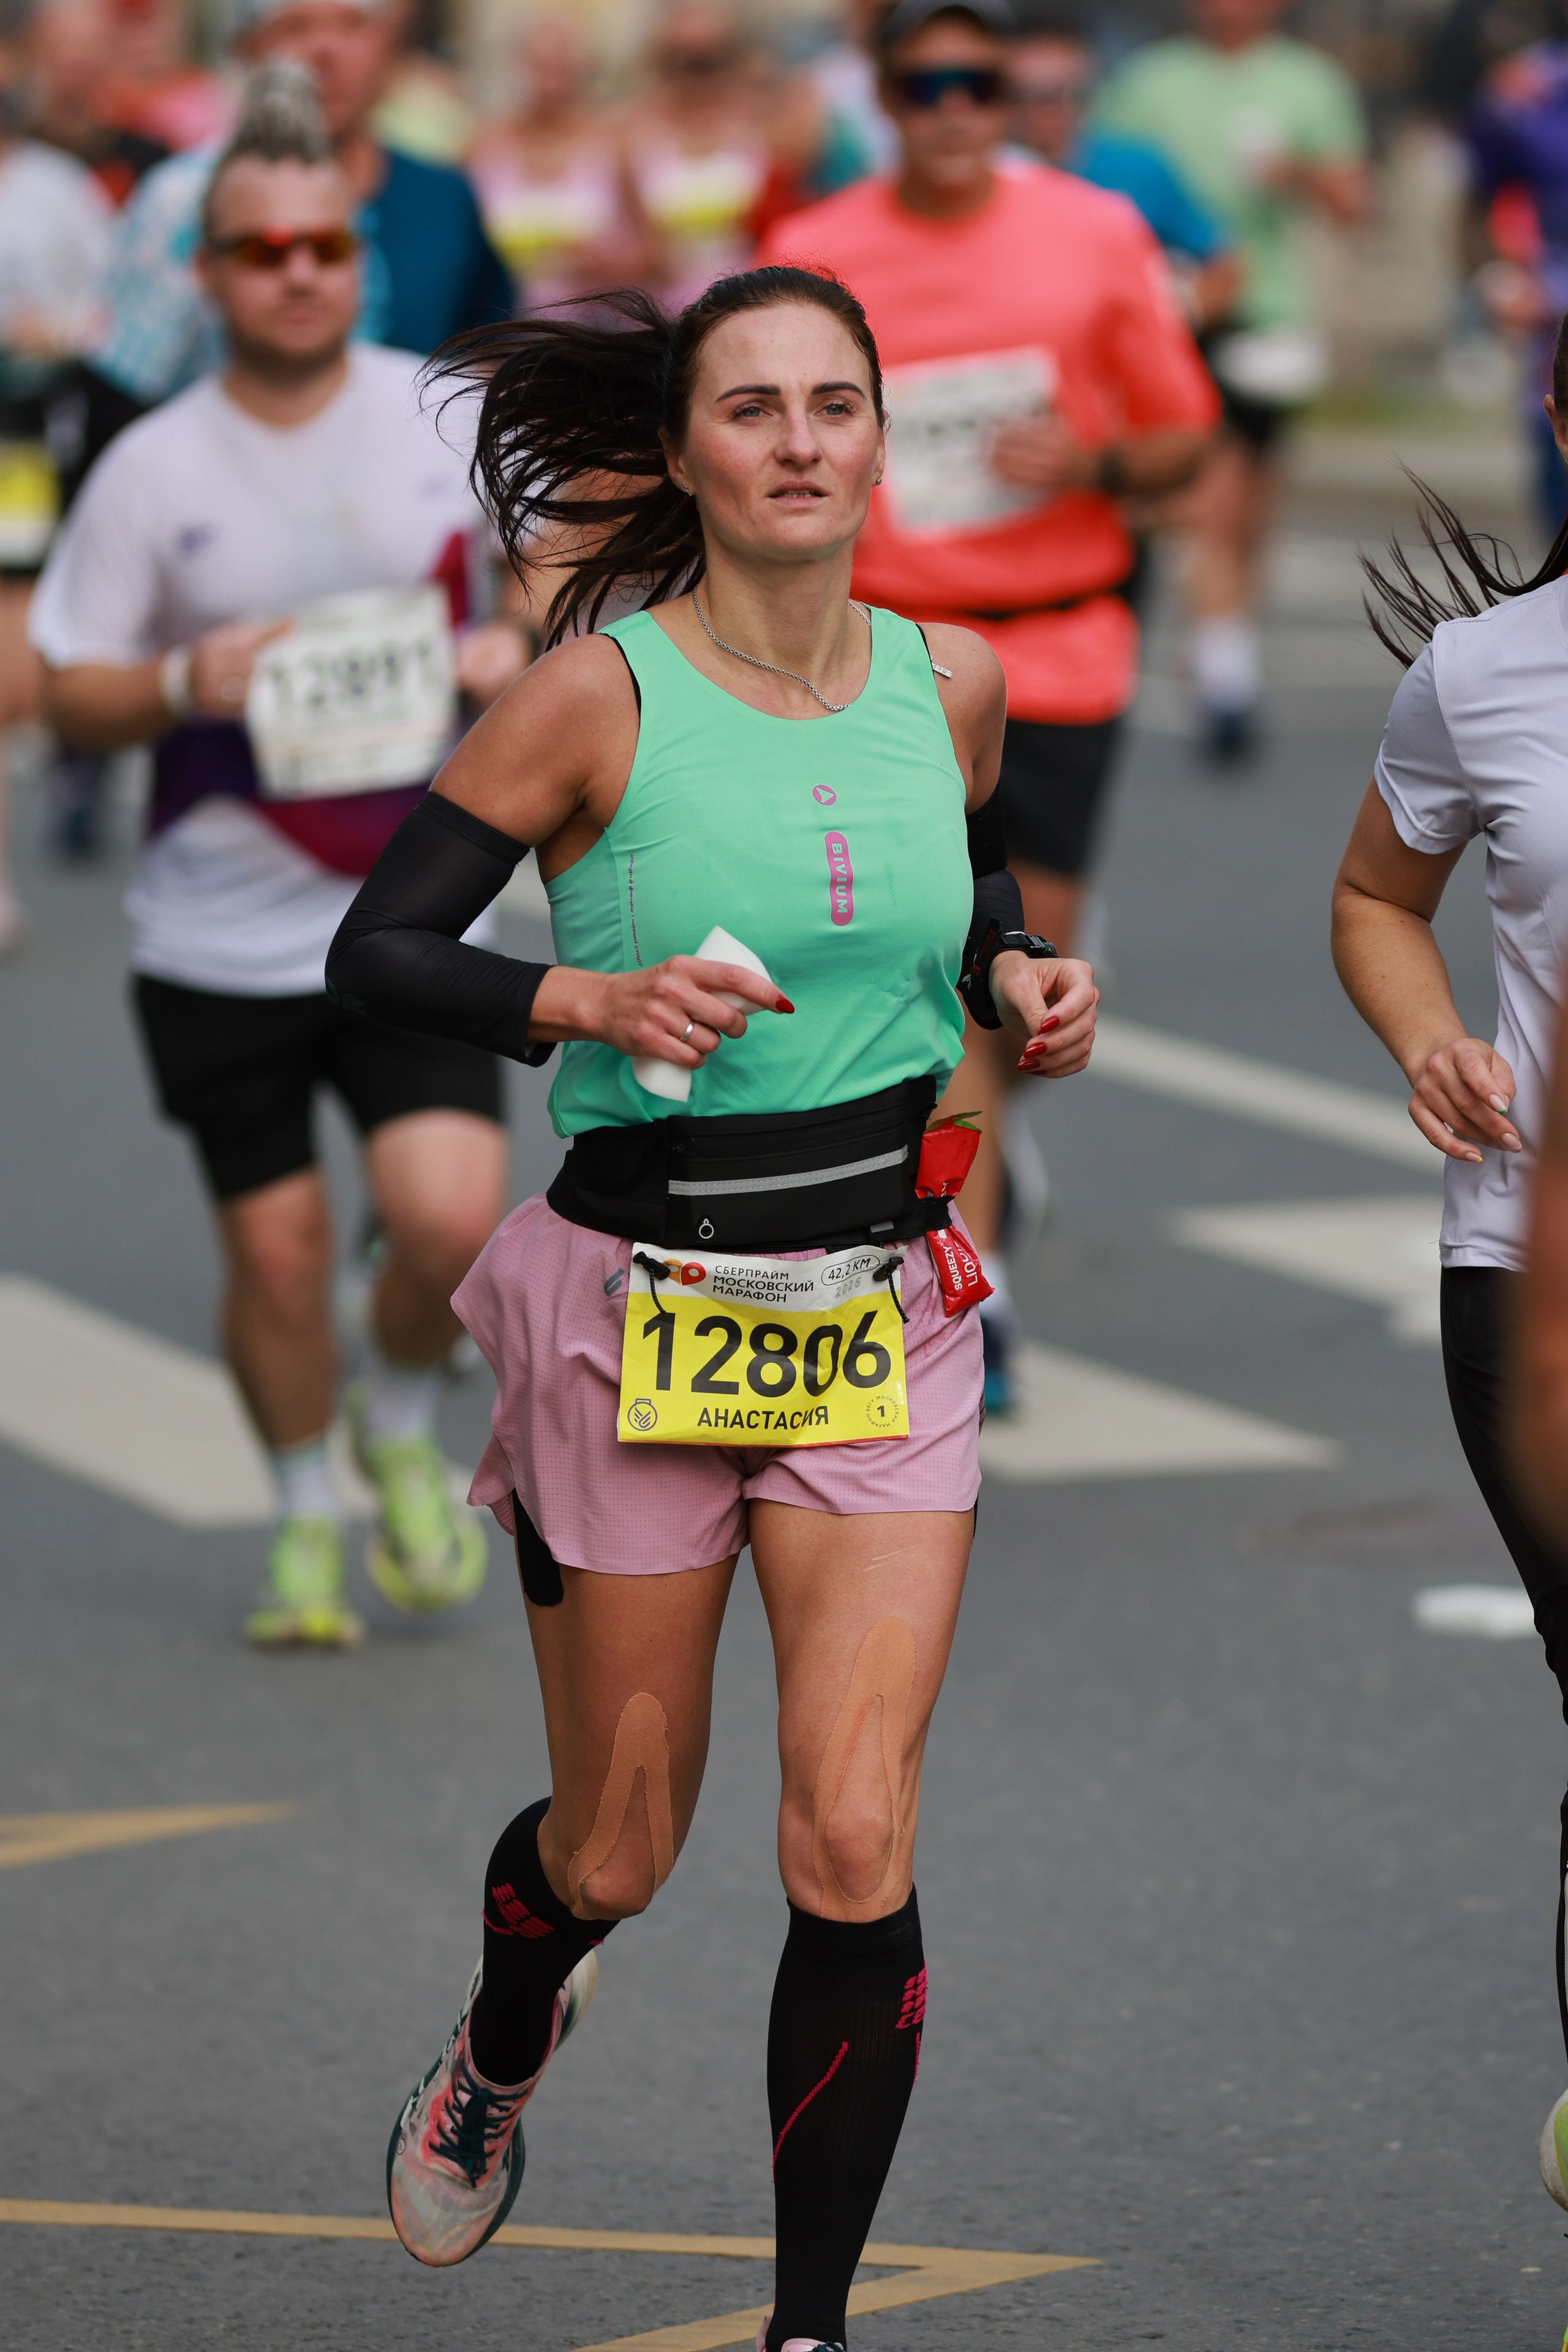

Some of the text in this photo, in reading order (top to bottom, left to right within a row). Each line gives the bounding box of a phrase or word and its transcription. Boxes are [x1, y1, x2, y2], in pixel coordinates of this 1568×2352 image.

[831, 842, 848, 913] BIVIUM
[715, 1265, 789, 1281] СБЕРПРАЙМ
[827, 1264, 851, 1281] 42,2
[943, 1246, 963, 1291] SQUEEZY
[713, 1276, 814, 1292] МОСКОВСКИЙ
[834, 1277, 862, 1298] 2026
[712, 1286, 787, 1303] МАРАФОН
[643, 1310, 892, 1398] 12806
[697, 1405, 829, 1430] АНАСТАСИЯ
[876, 1395, 899, 1423] МОСКОВСКИЙ
[876, 1405, 885, 1417] 1
[865, 1414, 891, 1428] МАРАФОН
